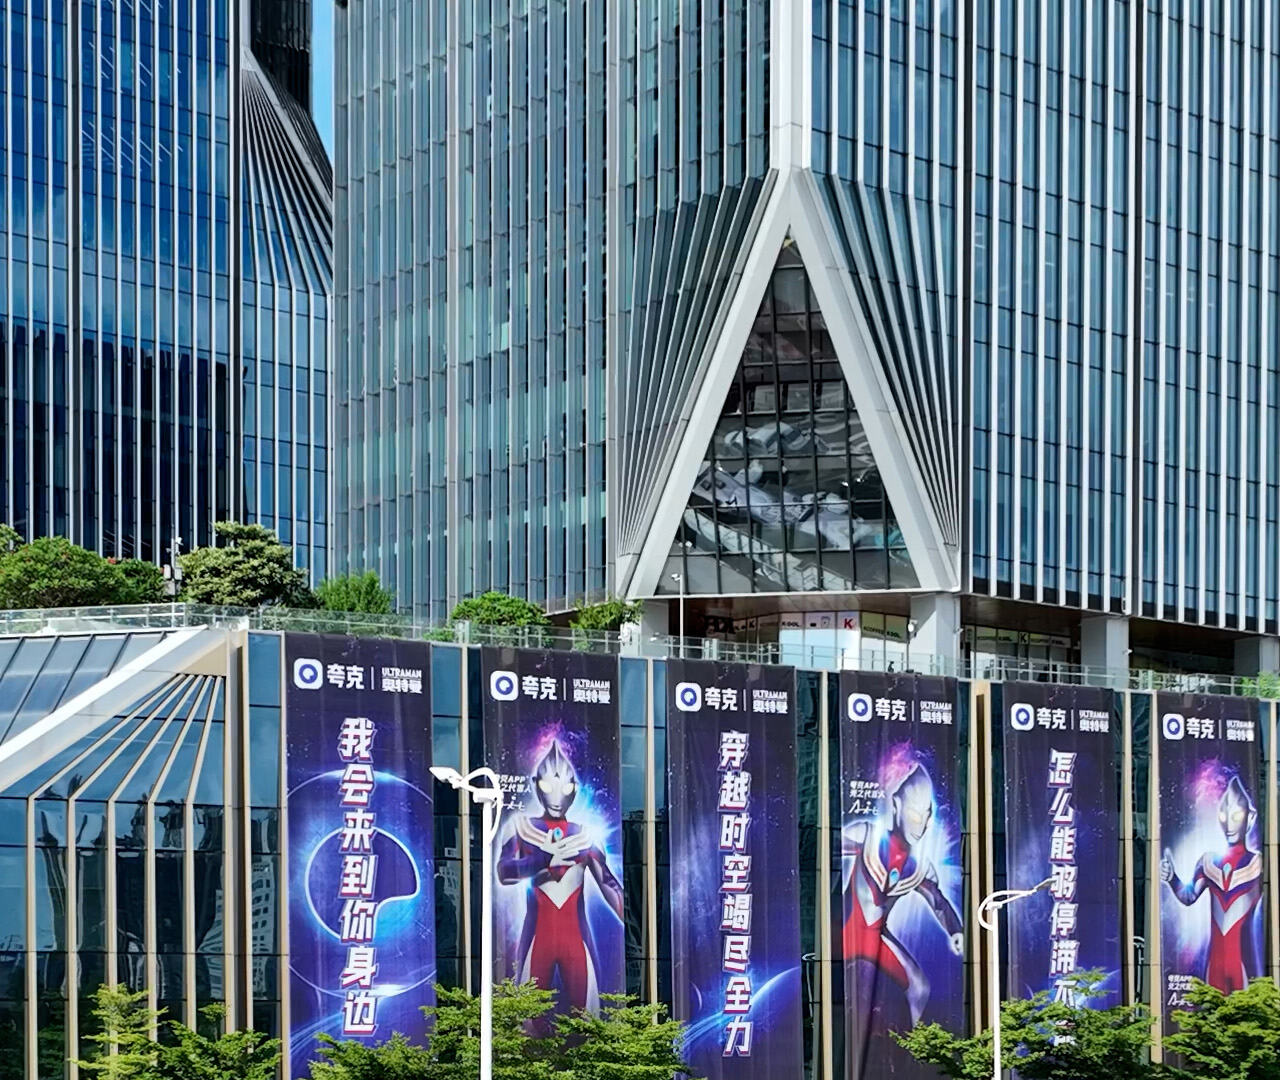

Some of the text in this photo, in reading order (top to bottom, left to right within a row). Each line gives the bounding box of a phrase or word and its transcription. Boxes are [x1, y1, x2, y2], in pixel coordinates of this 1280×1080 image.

[326, 663, 365, 690] 夸克
[381, 667, 422, 678] ULTRAMAN
[573, 678, 610, 689] ULTRAMAN
[381, 679, 423, 694] 奥特曼
[522, 675, 558, 701] 夸克
[573, 690, 611, 704] 奥特曼
[704, 687, 738, 711] 夸克
[752, 700, 788, 714] 奥特曼
[875, 698, 907, 722] 夸克
[920, 711, 953, 725] 奥特曼
[1036, 707, 1067, 730] 夸克
[1186, 717, 1215, 740] 夸克
[337, 716, 378, 1037] 我会来到你身边
[717, 729, 754, 1057] 穿越时空竭尽全力
[1047, 748, 1078, 1047] 怎么能够停滞不
